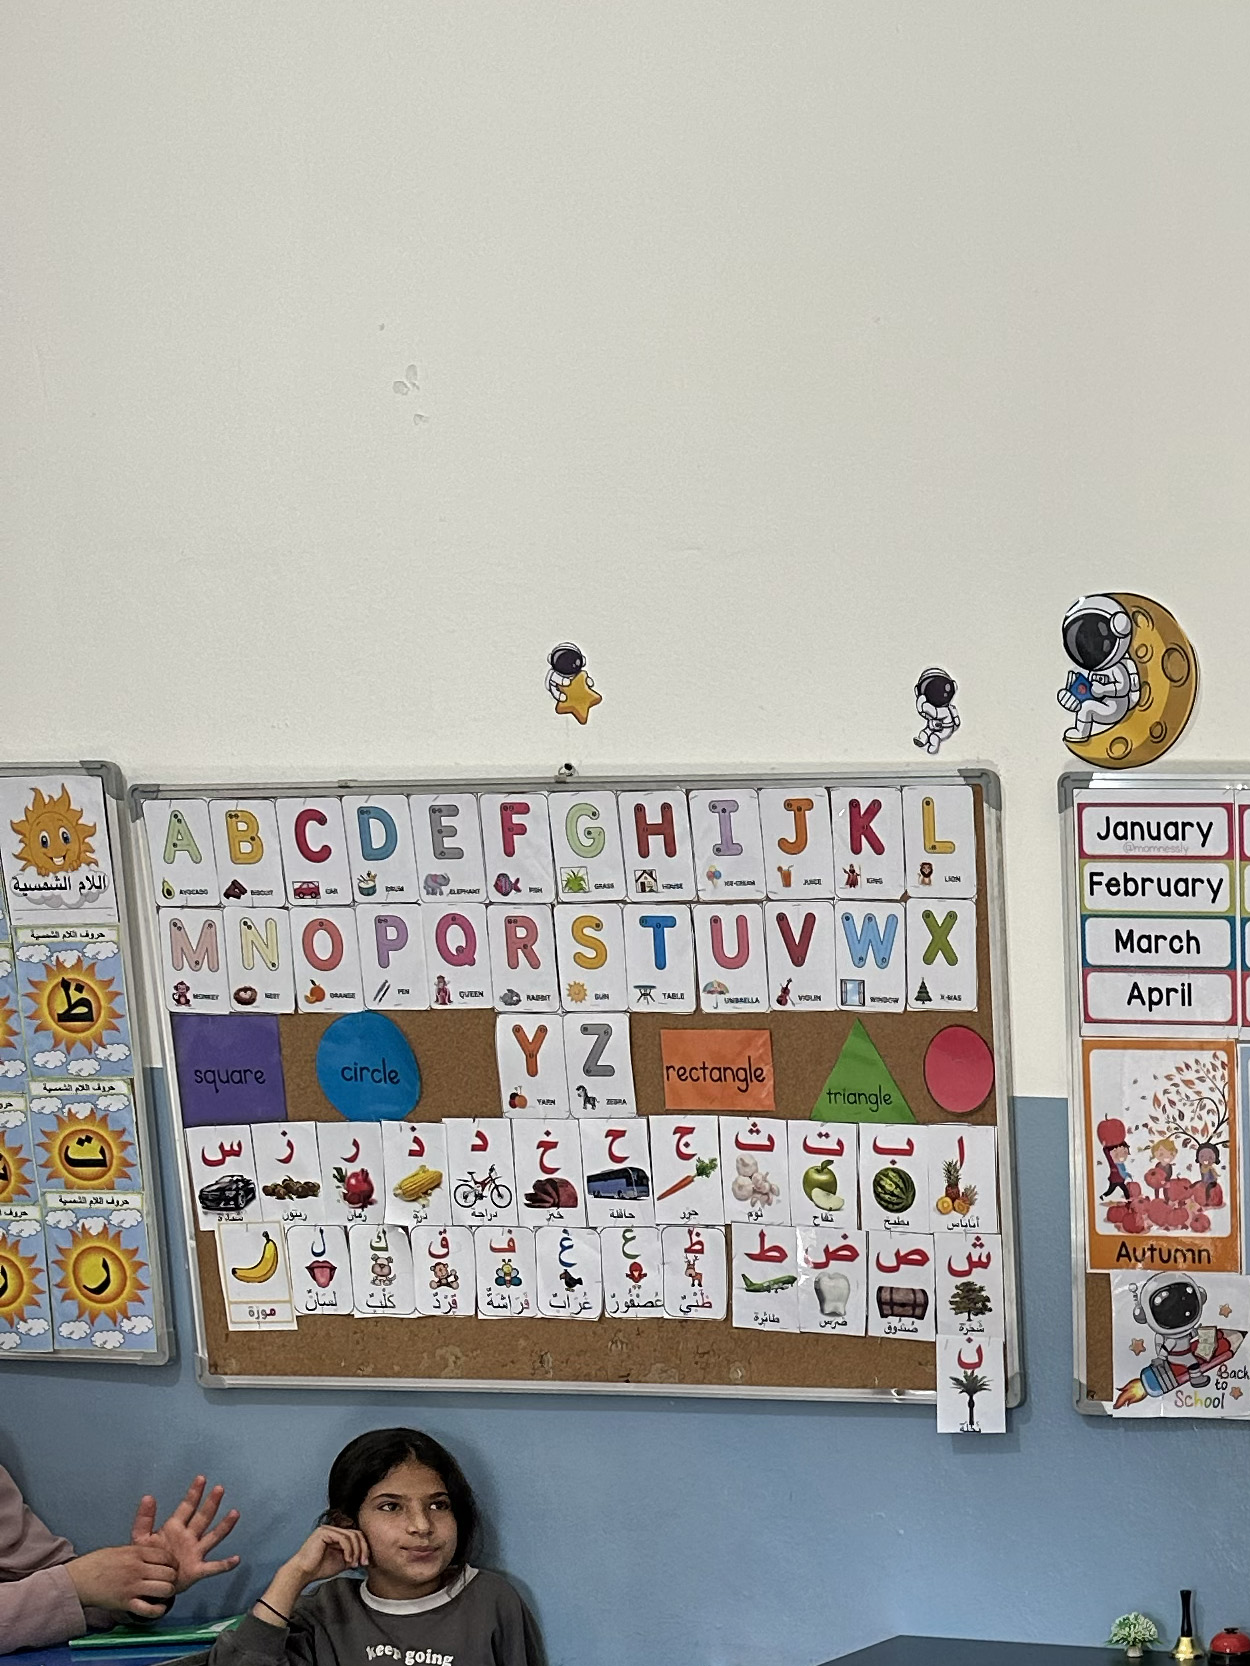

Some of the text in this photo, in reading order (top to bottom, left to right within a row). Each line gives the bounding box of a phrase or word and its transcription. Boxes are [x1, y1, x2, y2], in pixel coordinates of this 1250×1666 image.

[163, 810, 202, 864] A
[226, 810, 264, 864] B
[295, 808, 332, 863] C
[357, 806, 398, 861] D
[428, 804, 464, 860] E
[500, 802, 530, 857] F
[566, 802, 606, 858] G
[634, 802, 677, 858] H
[708, 800, 743, 856] I
[778, 798, 814, 855] J
[848, 798, 885, 856] K
[922, 796, 956, 854] L
[1096, 816, 1214, 848] January
[14, 875, 106, 896] اللام الشمسية
[1089, 872, 1224, 904] February
[169, 918, 219, 972] M
[240, 916, 279, 971] N
[302, 918, 343, 972] O
[374, 914, 408, 968] P
[435, 912, 476, 967] Q
[504, 916, 541, 970] R
[572, 916, 608, 970] S
[639, 916, 676, 970] T
[710, 914, 750, 970] U
[776, 912, 816, 968] V
[841, 912, 898, 969] W
[922, 910, 958, 966] X
[1115, 929, 1200, 954] March
[56, 977, 94, 1022] ظ
[1127, 982, 1192, 1012] April
[512, 1024, 548, 1078] Y
[580, 1023, 616, 1077] Z
[194, 1068, 266, 1094] square
[341, 1058, 400, 1084] circle
[666, 1056, 766, 1093] rectangle
[826, 1084, 892, 1112] triangle
[64, 1134, 108, 1168] ت
[202, 1140, 242, 1167] س
[275, 1130, 294, 1164] ز
[340, 1138, 360, 1163] ر
[408, 1126, 426, 1157] ذ
[471, 1130, 488, 1152] د
[536, 1130, 562, 1174] خ
[605, 1128, 630, 1164] ح
[672, 1126, 697, 1160] ج
[734, 1122, 775, 1152] ث
[802, 1132, 844, 1156] ت
[872, 1136, 914, 1166] ب
[311, 1227, 326, 1257] ل
[428, 1228, 450, 1259] ق
[490, 1228, 516, 1253] ف
[558, 1228, 576, 1267] غ
[622, 1228, 640, 1259] ع
[684, 1228, 704, 1254] ظ
[744, 1229, 788, 1263] ط
[804, 1233, 860, 1269] ض
[947, 1236, 991, 1277] ش
[1116, 1241, 1212, 1264] Autumn
[82, 1258, 110, 1295] ر
[876, 1248, 930, 1273] ص
[957, 1337, 984, 1370] ن
[1217, 1363, 1250, 1380] Back
[1175, 1390, 1225, 1409] School
[1215, 1379, 1228, 1390] to
